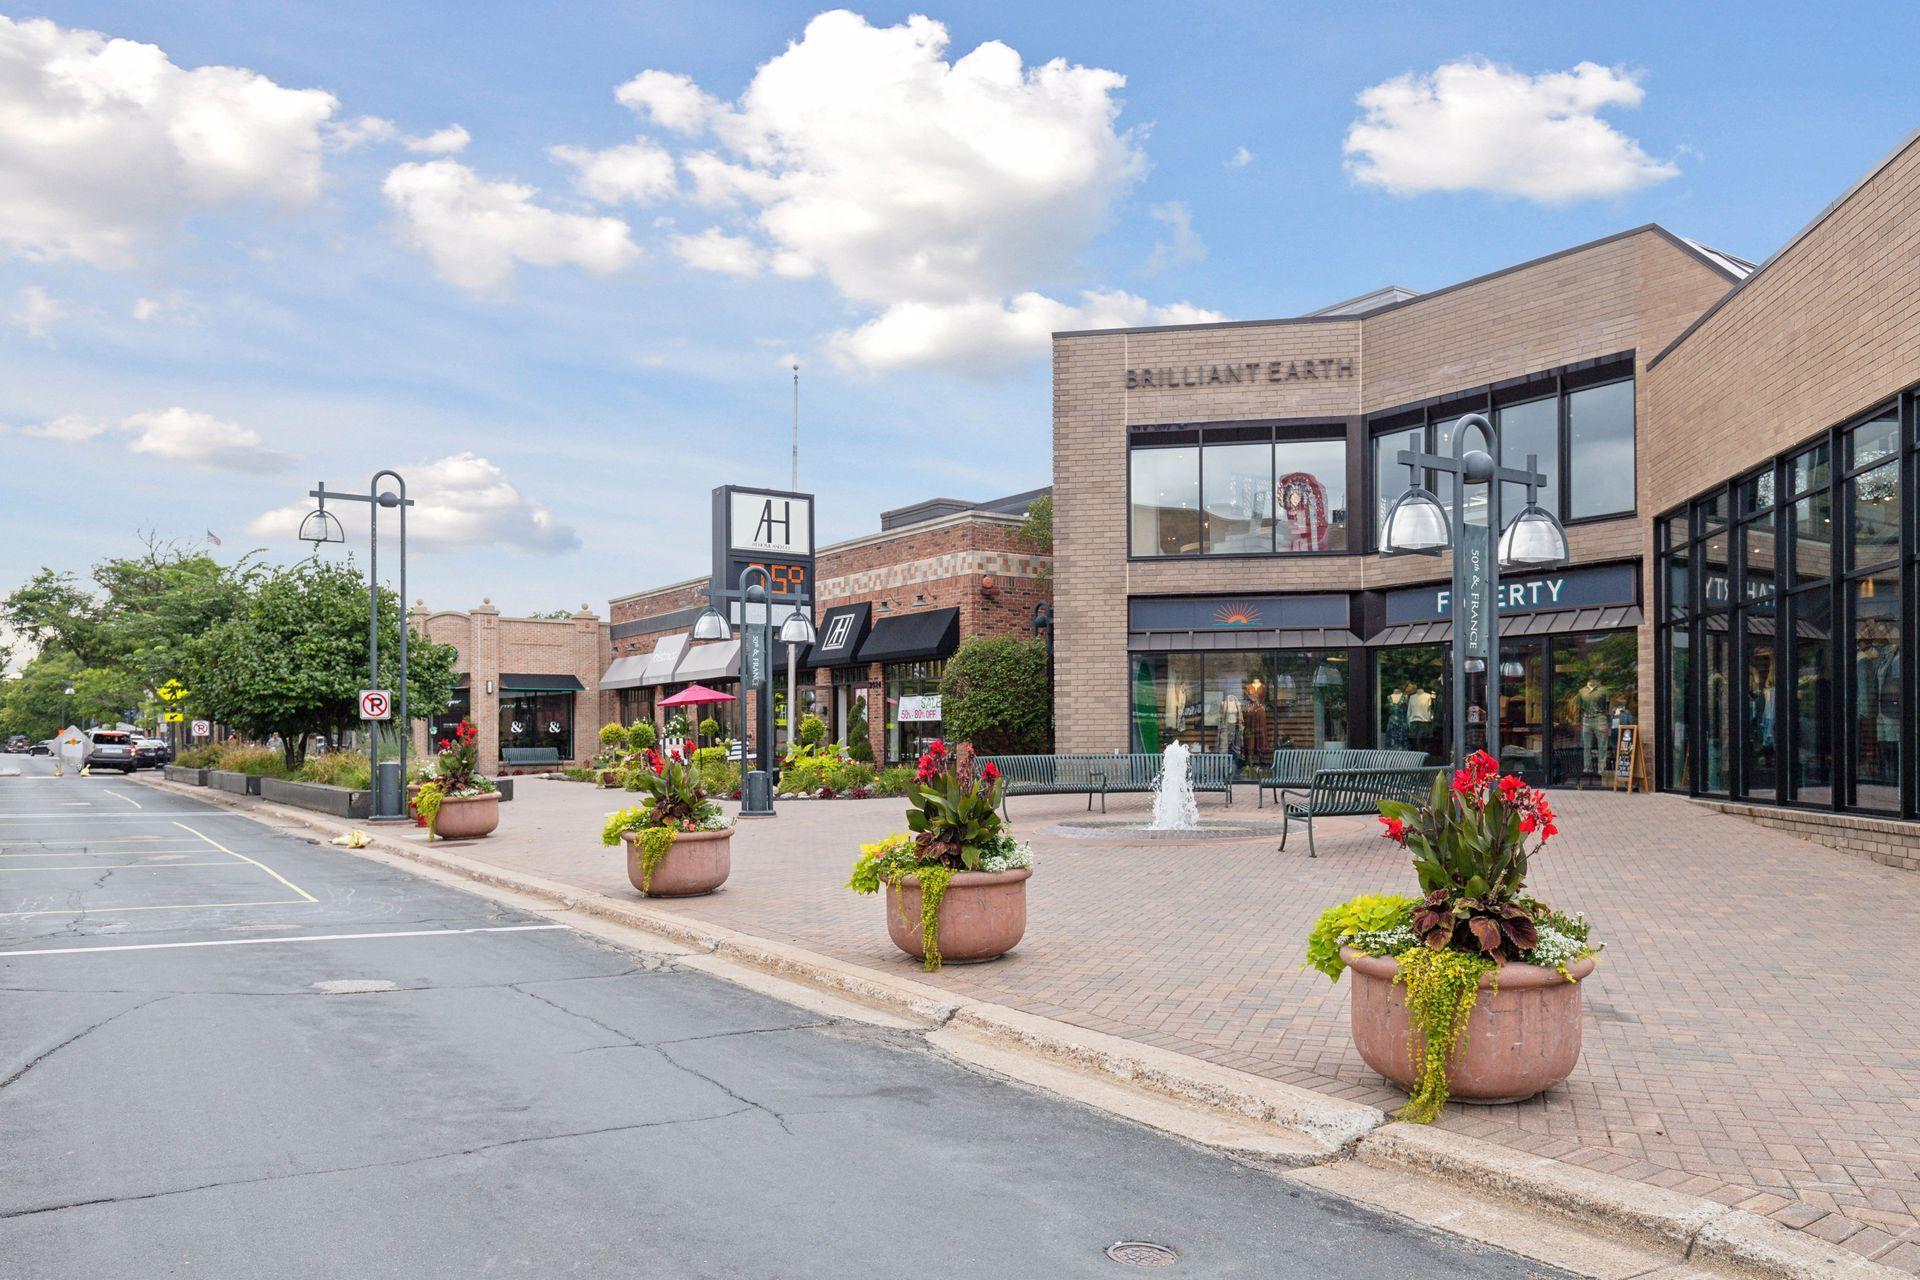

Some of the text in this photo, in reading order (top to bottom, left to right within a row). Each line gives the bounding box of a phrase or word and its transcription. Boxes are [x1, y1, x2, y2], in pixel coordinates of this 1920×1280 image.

[1125, 358, 1354, 389] BRILLIANT EARTH
[753, 499, 790, 545] AH
[1437, 579, 1564, 613] FERTY
[1469, 548, 1480, 649] 50th & FRANCE
[752, 649, 759, 657] &
[920, 697, 941, 709] SALE
[925, 709, 937, 719] OFF
[510, 720, 561, 733] & &
